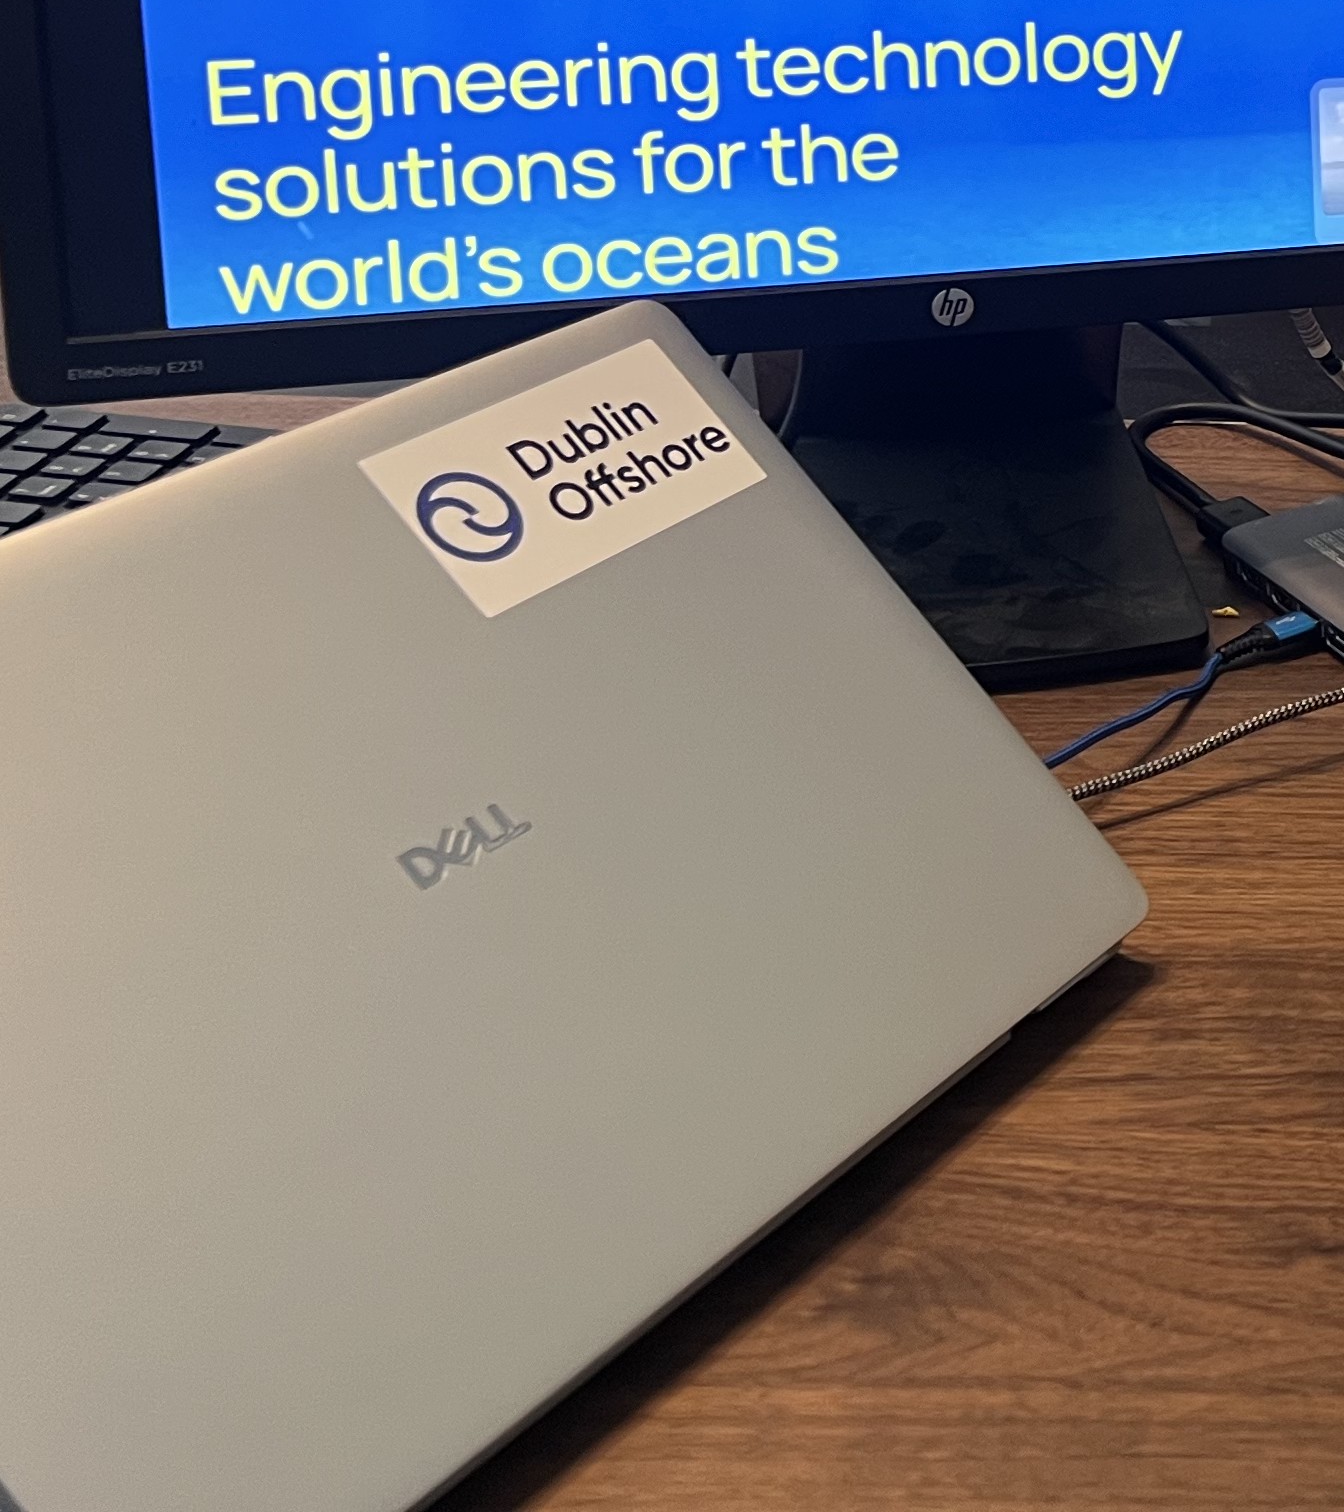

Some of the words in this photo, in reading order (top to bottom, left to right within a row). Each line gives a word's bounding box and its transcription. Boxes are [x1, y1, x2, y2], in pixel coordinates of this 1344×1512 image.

[206, 42, 719, 140] Engineering
[735, 21, 1183, 98] technology
[214, 143, 616, 221] solutions
[633, 130, 745, 194] for
[761, 123, 899, 186] the
[218, 235, 523, 315] world’s
[542, 225, 839, 293] oceans
[936, 288, 970, 326] hp
[505, 402, 659, 481] Dublin
[549, 426, 731, 521] Offshore
[395, 803, 533, 891] DELL
